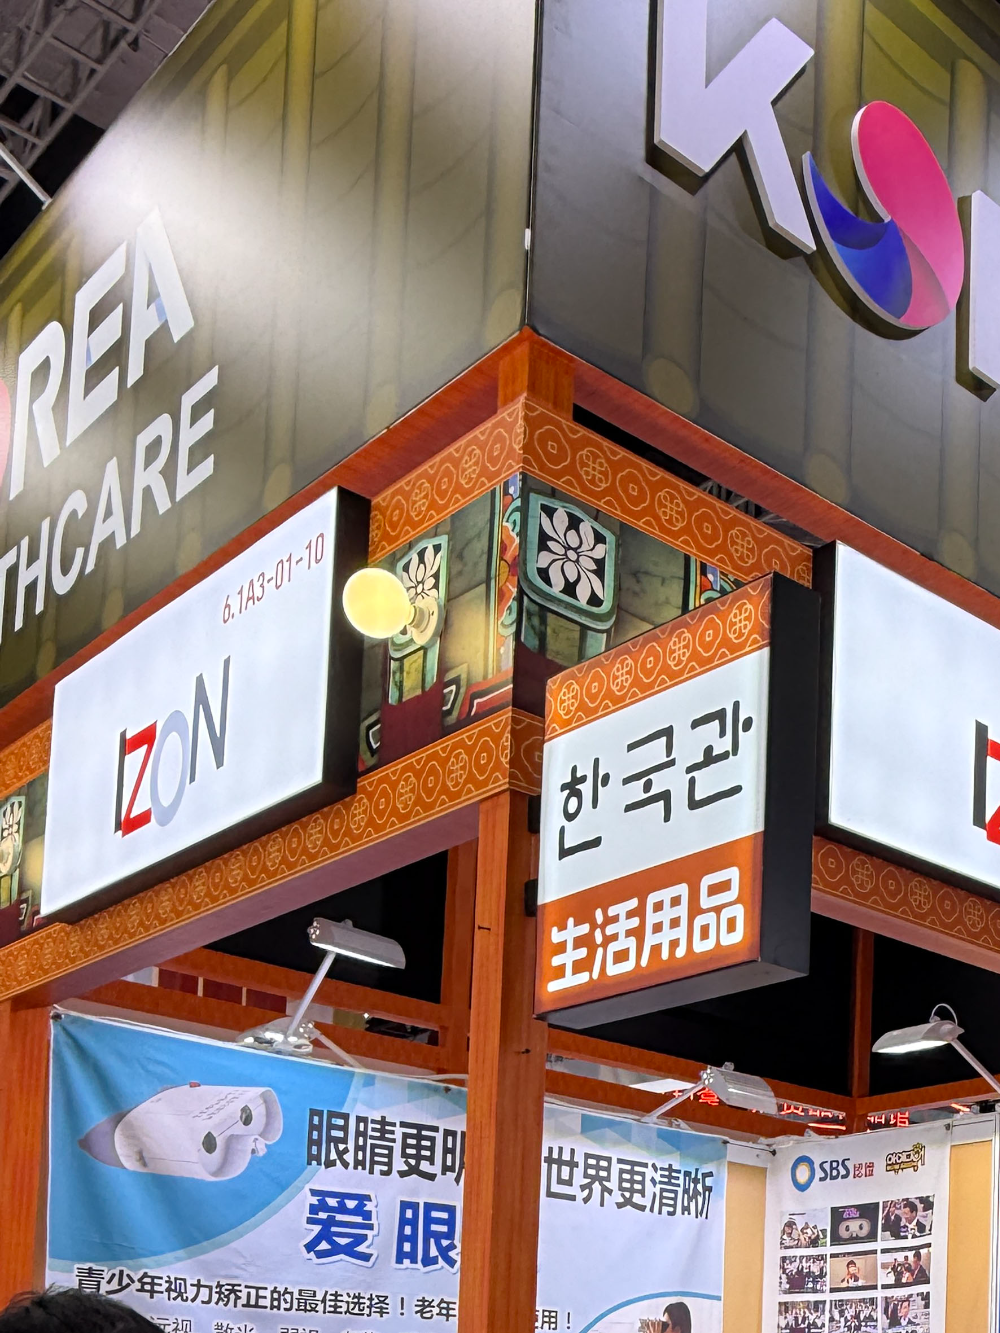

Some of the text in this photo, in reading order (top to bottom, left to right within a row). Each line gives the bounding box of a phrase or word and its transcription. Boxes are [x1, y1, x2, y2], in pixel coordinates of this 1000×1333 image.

[0, 205, 195, 500] REA
[222, 532, 325, 624] 6.1A3-01-10
[114, 655, 231, 838] IZON
[558, 700, 754, 861] 한국관
[547, 866, 745, 994] 生活用品
[818, 1157, 851, 1182] SBS
